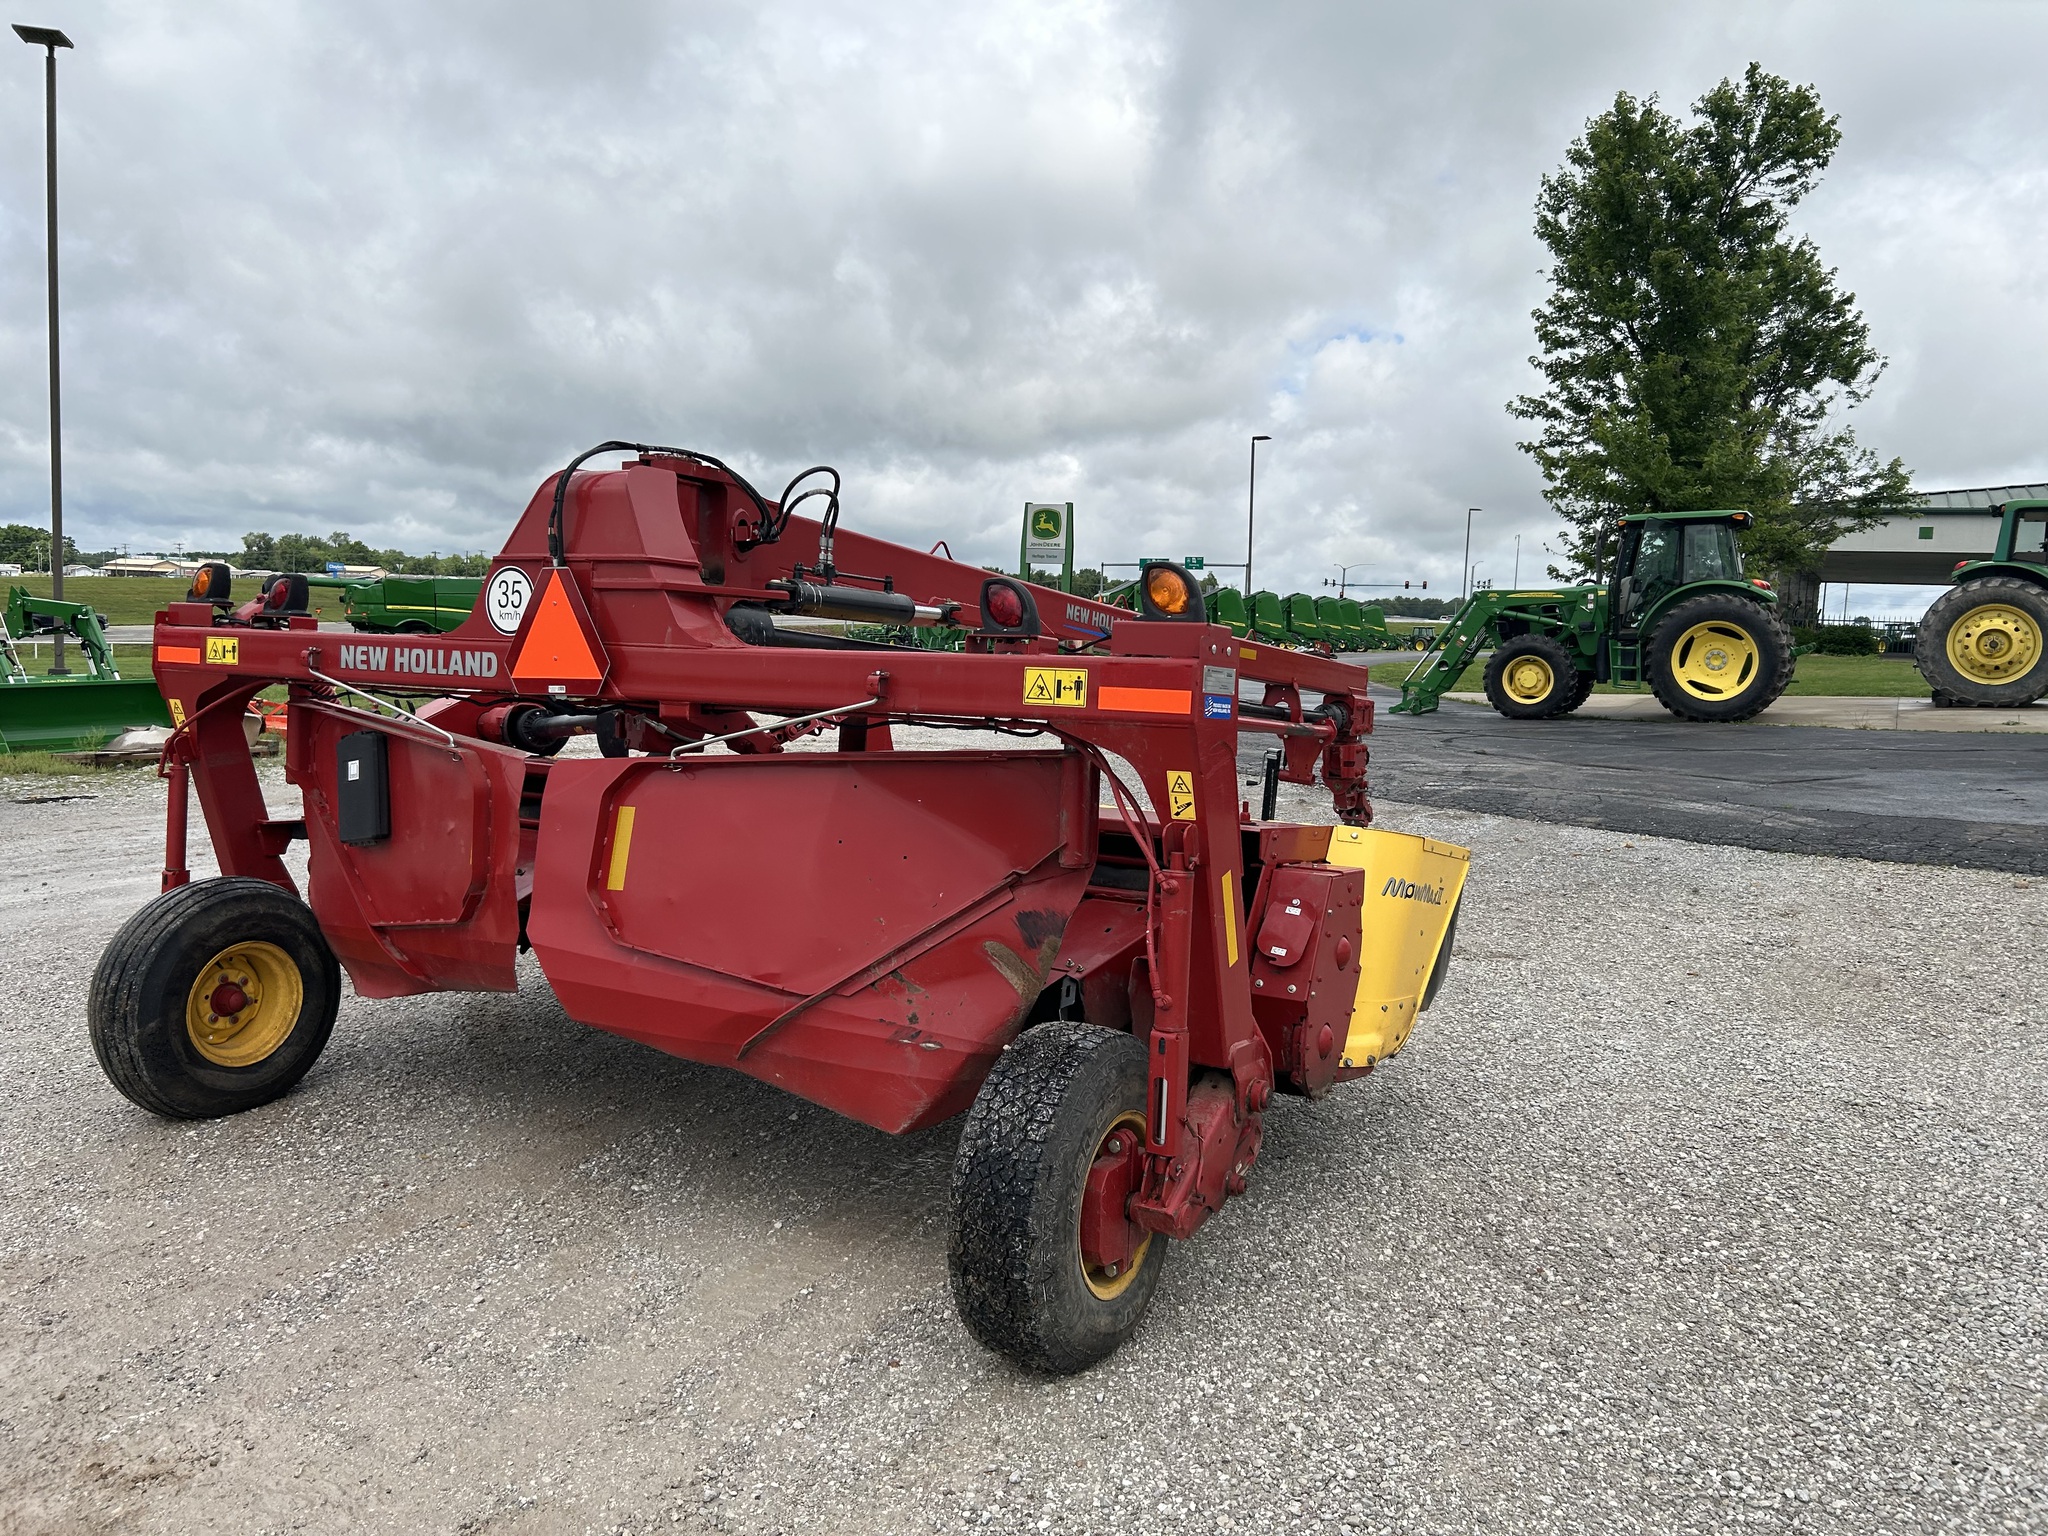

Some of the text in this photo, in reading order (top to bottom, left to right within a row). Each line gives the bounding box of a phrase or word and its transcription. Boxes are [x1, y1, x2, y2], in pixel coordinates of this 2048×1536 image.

[498, 580, 522, 608] 35
[499, 610, 521, 620] km/h
[1066, 603, 1090, 624] NEW
[340, 644, 498, 678] NEW HOLLAND
